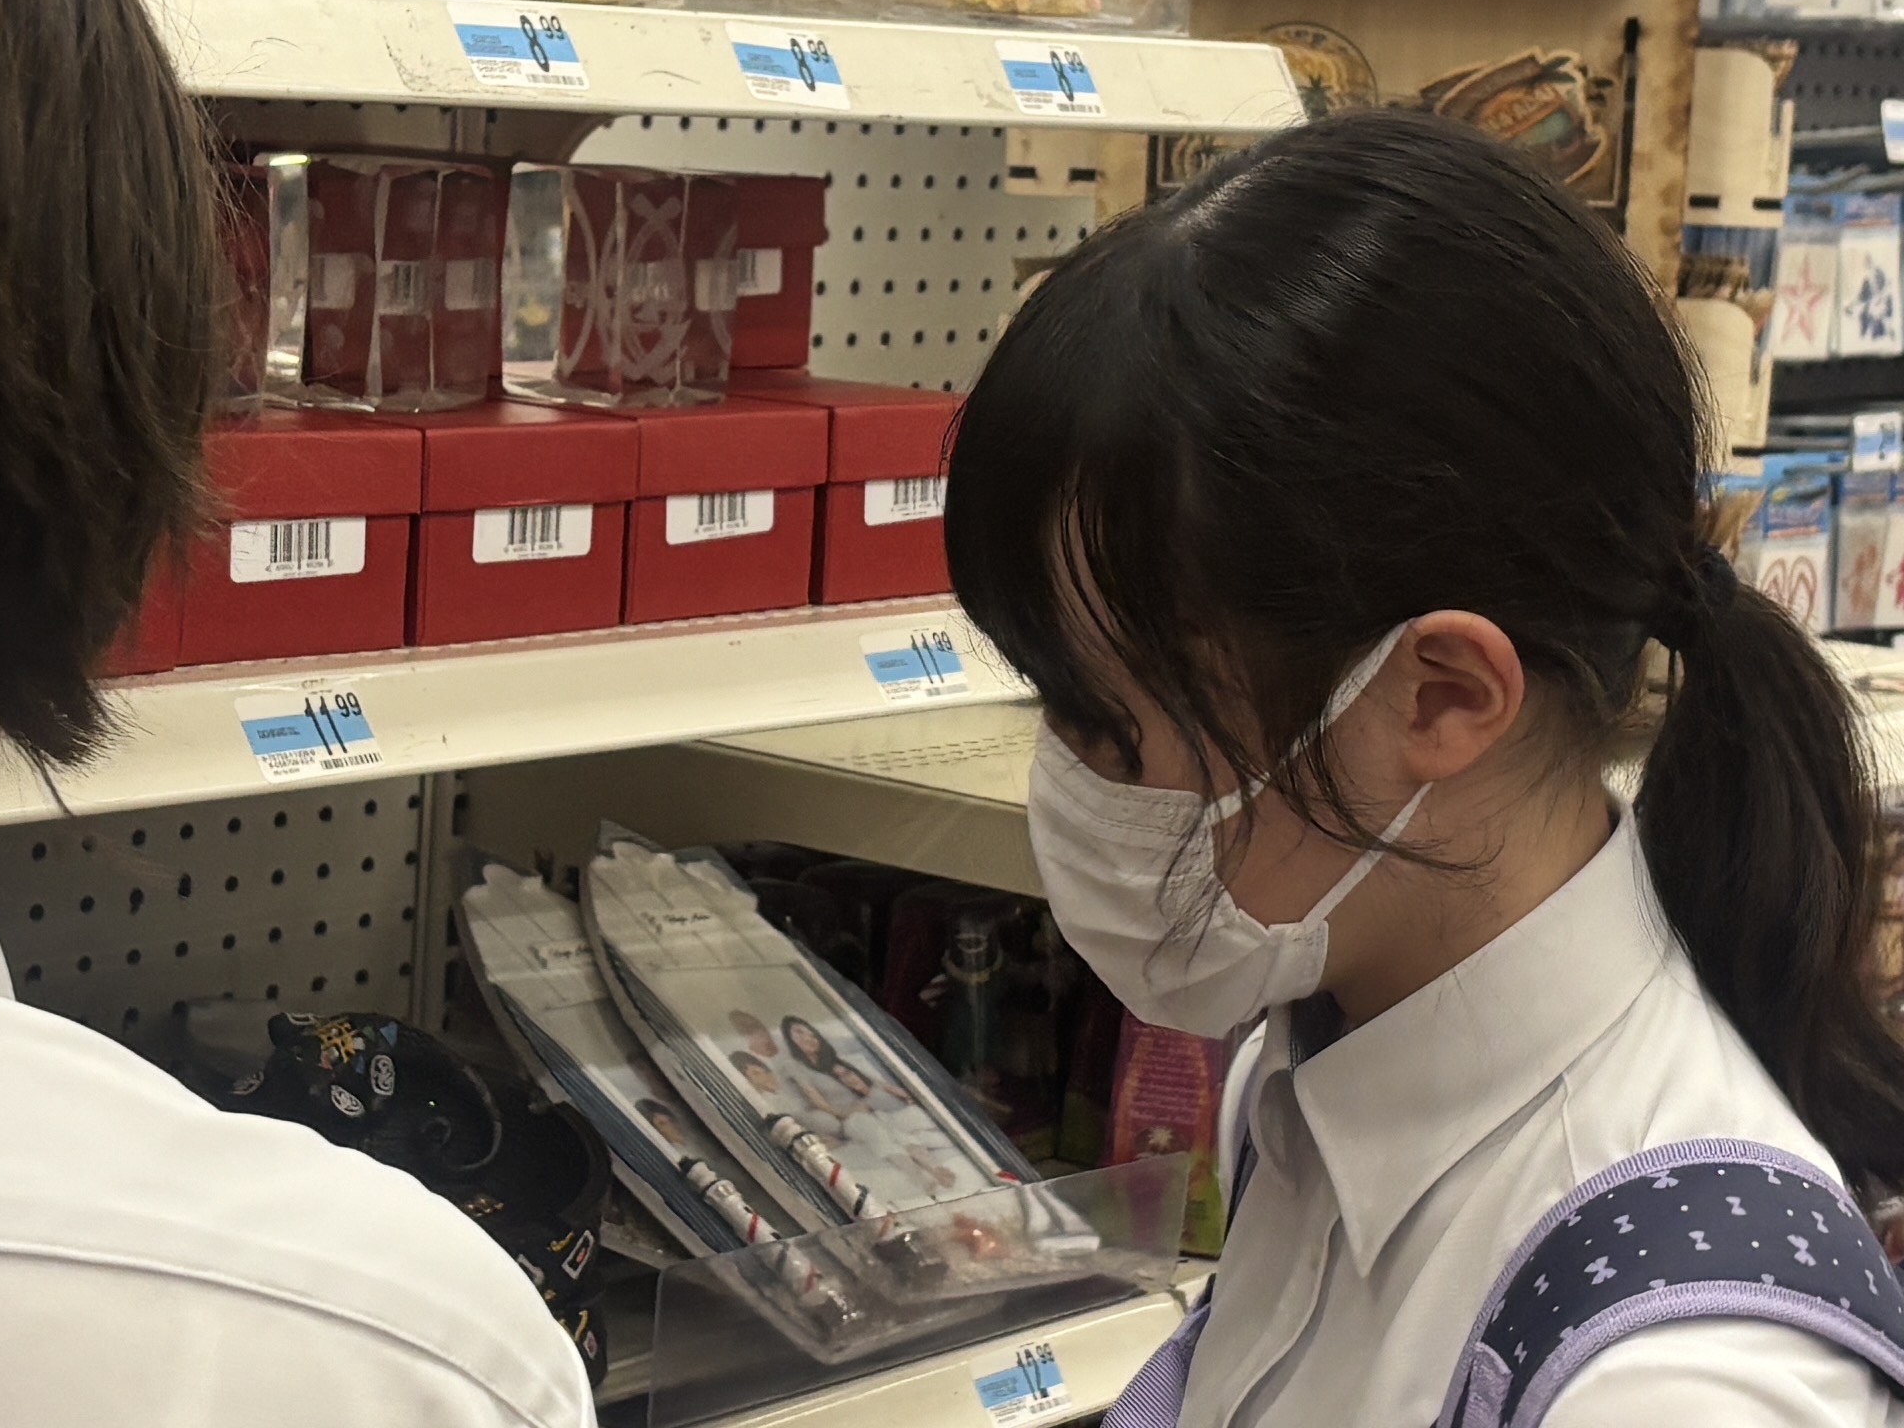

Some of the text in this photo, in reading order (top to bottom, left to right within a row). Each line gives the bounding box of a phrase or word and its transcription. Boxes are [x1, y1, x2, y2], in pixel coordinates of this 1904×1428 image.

[520, 14, 550, 73] 8
[539, 15, 565, 40] 99
[790, 37, 816, 92] 8
[807, 39, 830, 63] 99
[1049, 50, 1074, 102] 8
[304, 691, 363, 756] 11 99
